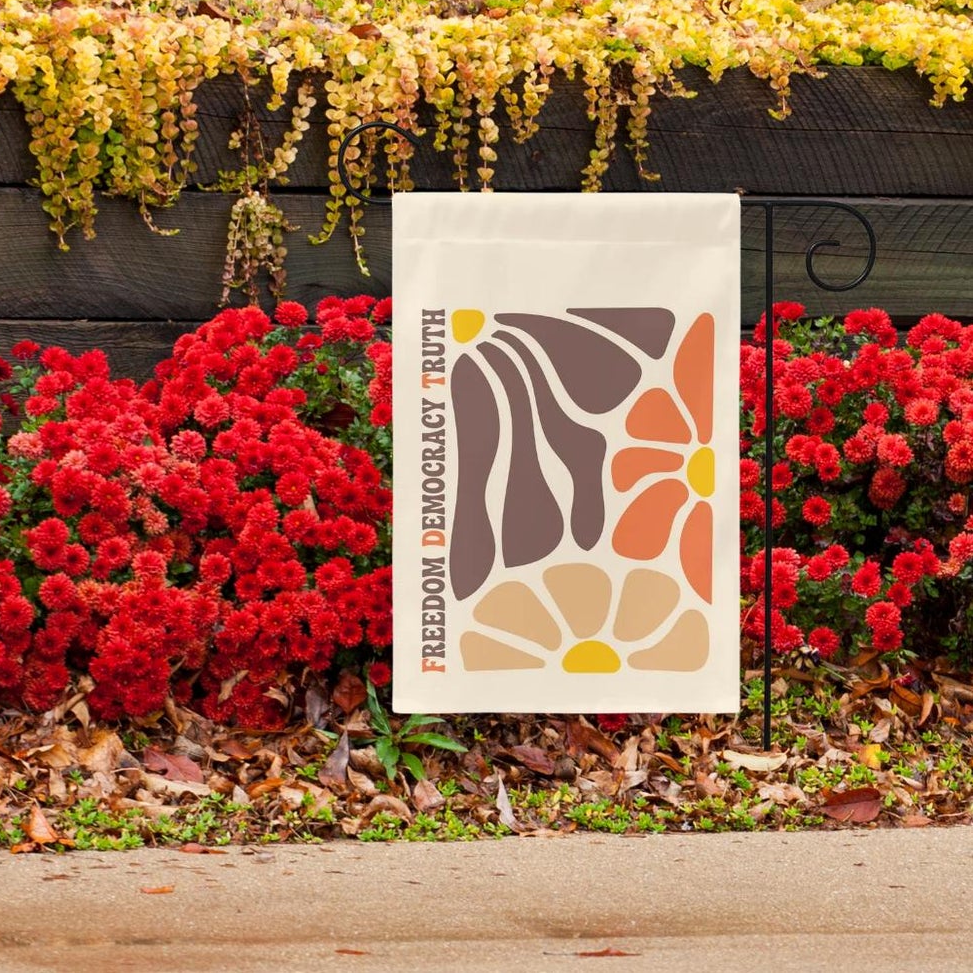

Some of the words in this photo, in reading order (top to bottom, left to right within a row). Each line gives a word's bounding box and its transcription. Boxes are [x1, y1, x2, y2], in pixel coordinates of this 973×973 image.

[421, 308, 446, 389] TRUTH
[421, 397, 446, 547] DEMOCRACY
[421, 556, 446, 673] FREEDOM
